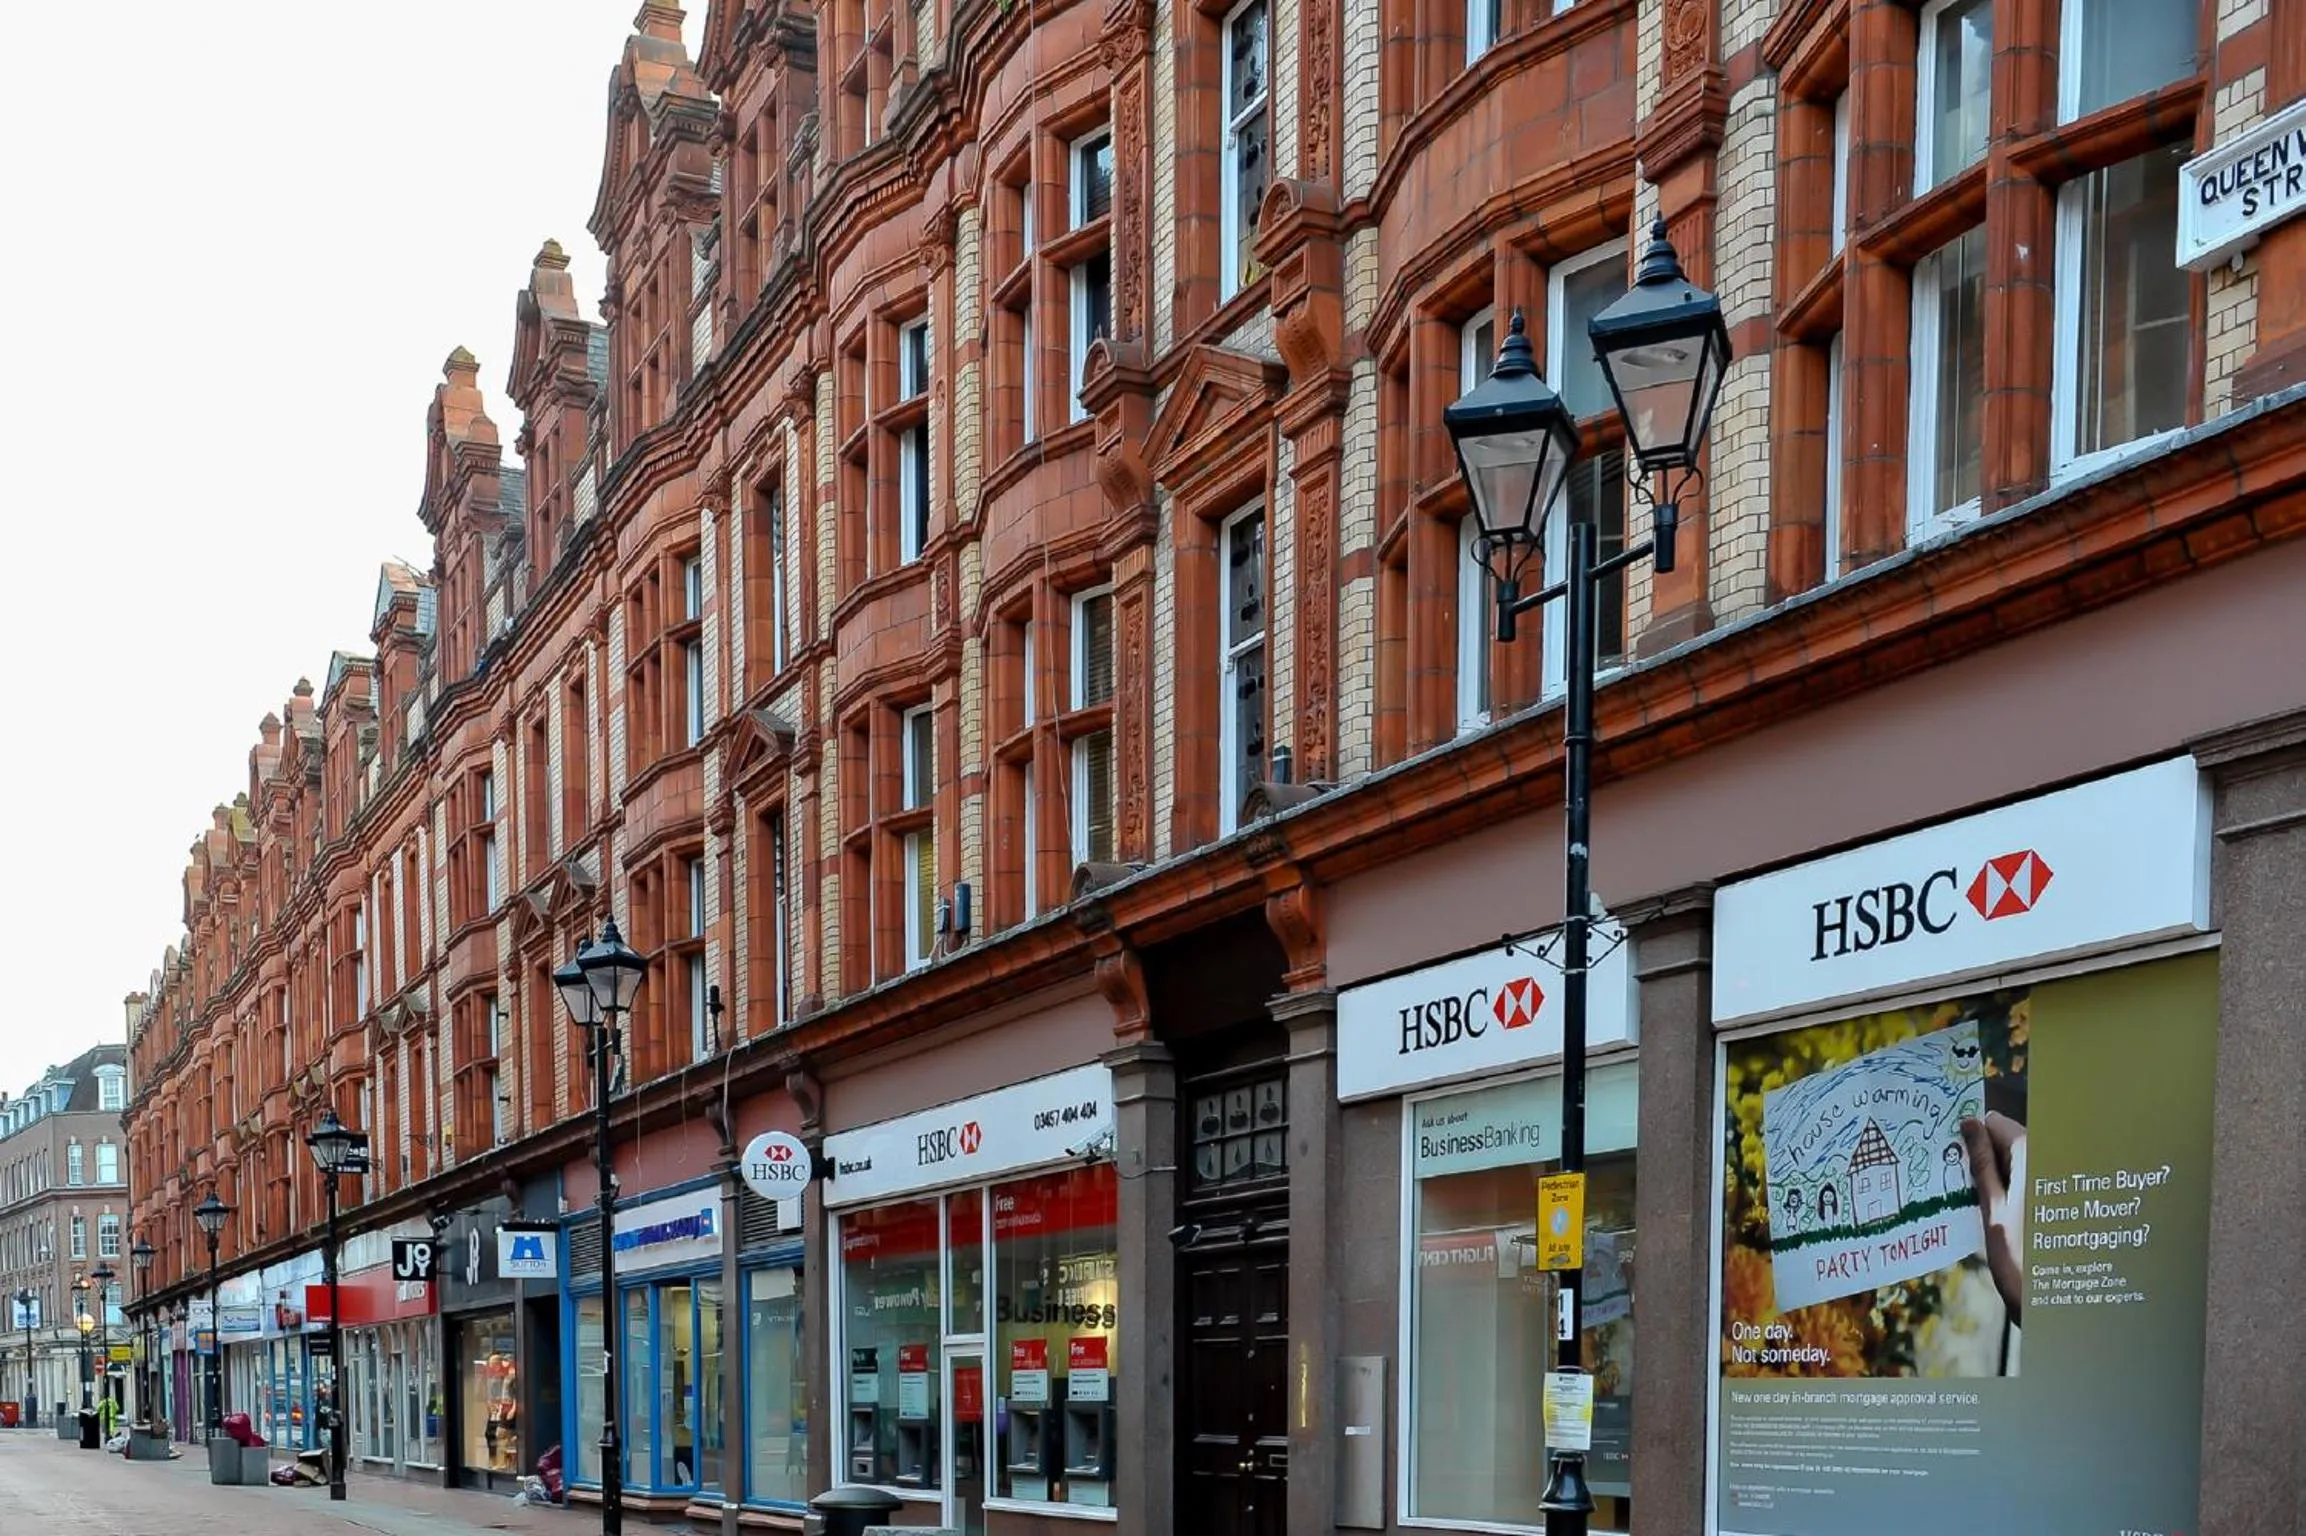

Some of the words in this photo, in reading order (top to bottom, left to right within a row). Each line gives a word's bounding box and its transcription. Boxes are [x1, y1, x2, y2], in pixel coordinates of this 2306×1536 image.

[2200, 133, 2290, 206] QUEEN
[1810, 867, 1957, 962] HSBC
[1399, 986, 1489, 1055] HSBC
[1788, 1104, 1845, 1166] house
[1852, 1087, 1942, 1141] warming
[917, 1126, 958, 1166] HSBC
[751, 1163, 806, 1182] HSBC
[2034, 1178, 2067, 1197] First
[2071, 1173, 2111, 1193] Time
[2116, 1164, 2171, 1191] Buyer?
[2034, 1204, 2080, 1223] Home
[2083, 1196, 2141, 1219] Mover?
[2033, 1223, 2151, 1250] Remortgaging?
[397, 1243, 431, 1277] JOY
[1816, 1245, 1872, 1281] PARTY
[1879, 1224, 1949, 1268] TONIGHT
[2031, 1264, 2060, 1277] Come
[2075, 1262, 2113, 1276] explore
[2032, 1279, 2050, 1290] The
[2051, 1279, 2099, 1291] Mortgage
[2100, 1275, 2128, 1288] Zone
[996, 1295, 1116, 1329] Business
[2030, 1295, 2049, 1306] and
[2050, 1293, 2072, 1305] chat
[2073, 1294, 2084, 1305] to
[2085, 1294, 2103, 1304] our
[1731, 1321, 1761, 1341] One
[1764, 1320, 1794, 1343] day.
[1731, 1345, 1758, 1364] Not
[1760, 1343, 1831, 1367] someday.
[1731, 1391, 1753, 1403] New
[1753, 1393, 1771, 1403] one
[1772, 1391, 1791, 1405] day
[1791, 1391, 1837, 1404] in-branch
[1839, 1392, 1889, 1406] mortgage
[1889, 1391, 1937, 1406] approval
